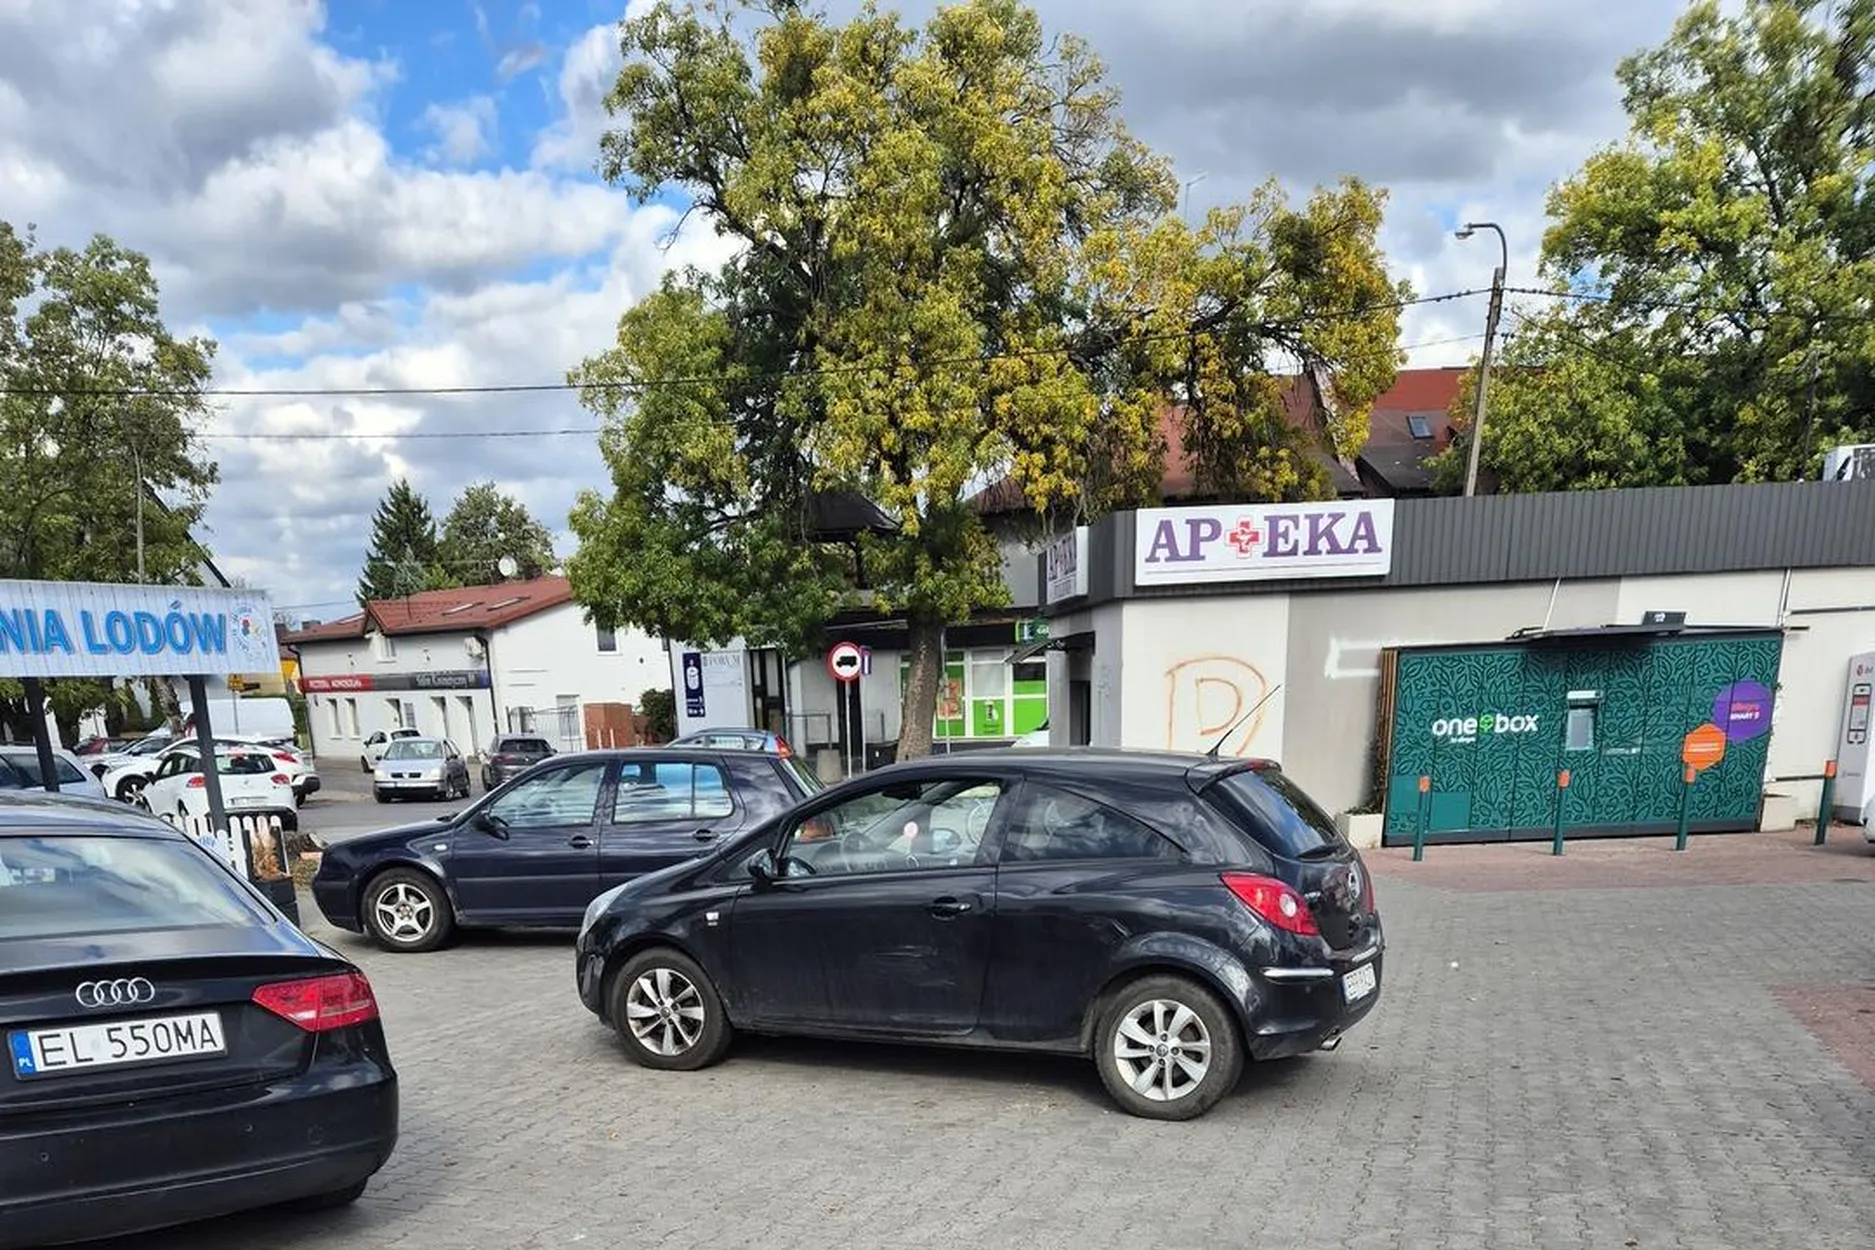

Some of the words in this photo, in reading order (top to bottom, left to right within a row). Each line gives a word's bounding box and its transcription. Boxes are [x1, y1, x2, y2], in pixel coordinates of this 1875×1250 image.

[80, 600, 228, 656] LODÓW
[1494, 713, 1540, 734] box
[37, 1032, 94, 1068] EL
[106, 1017, 218, 1059] 550MA
[18, 1057, 34, 1068] PL
